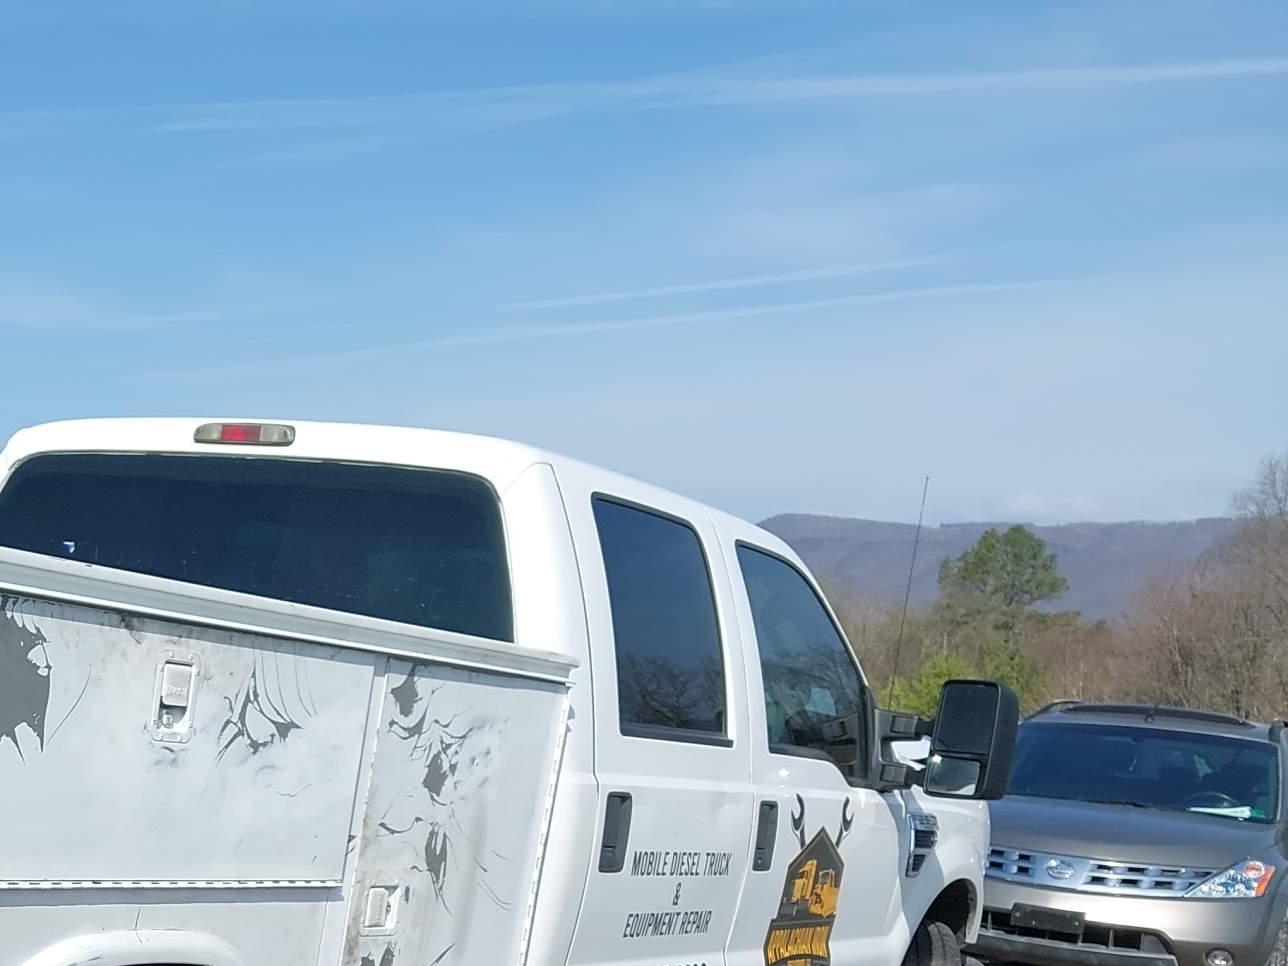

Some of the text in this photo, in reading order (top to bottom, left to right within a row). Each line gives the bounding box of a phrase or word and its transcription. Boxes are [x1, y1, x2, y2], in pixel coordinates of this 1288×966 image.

[630, 851, 733, 877] MOBILE DIESEL TRUCK
[672, 881, 682, 907] &
[622, 910, 713, 939] EQUIPMENT REPAIR
